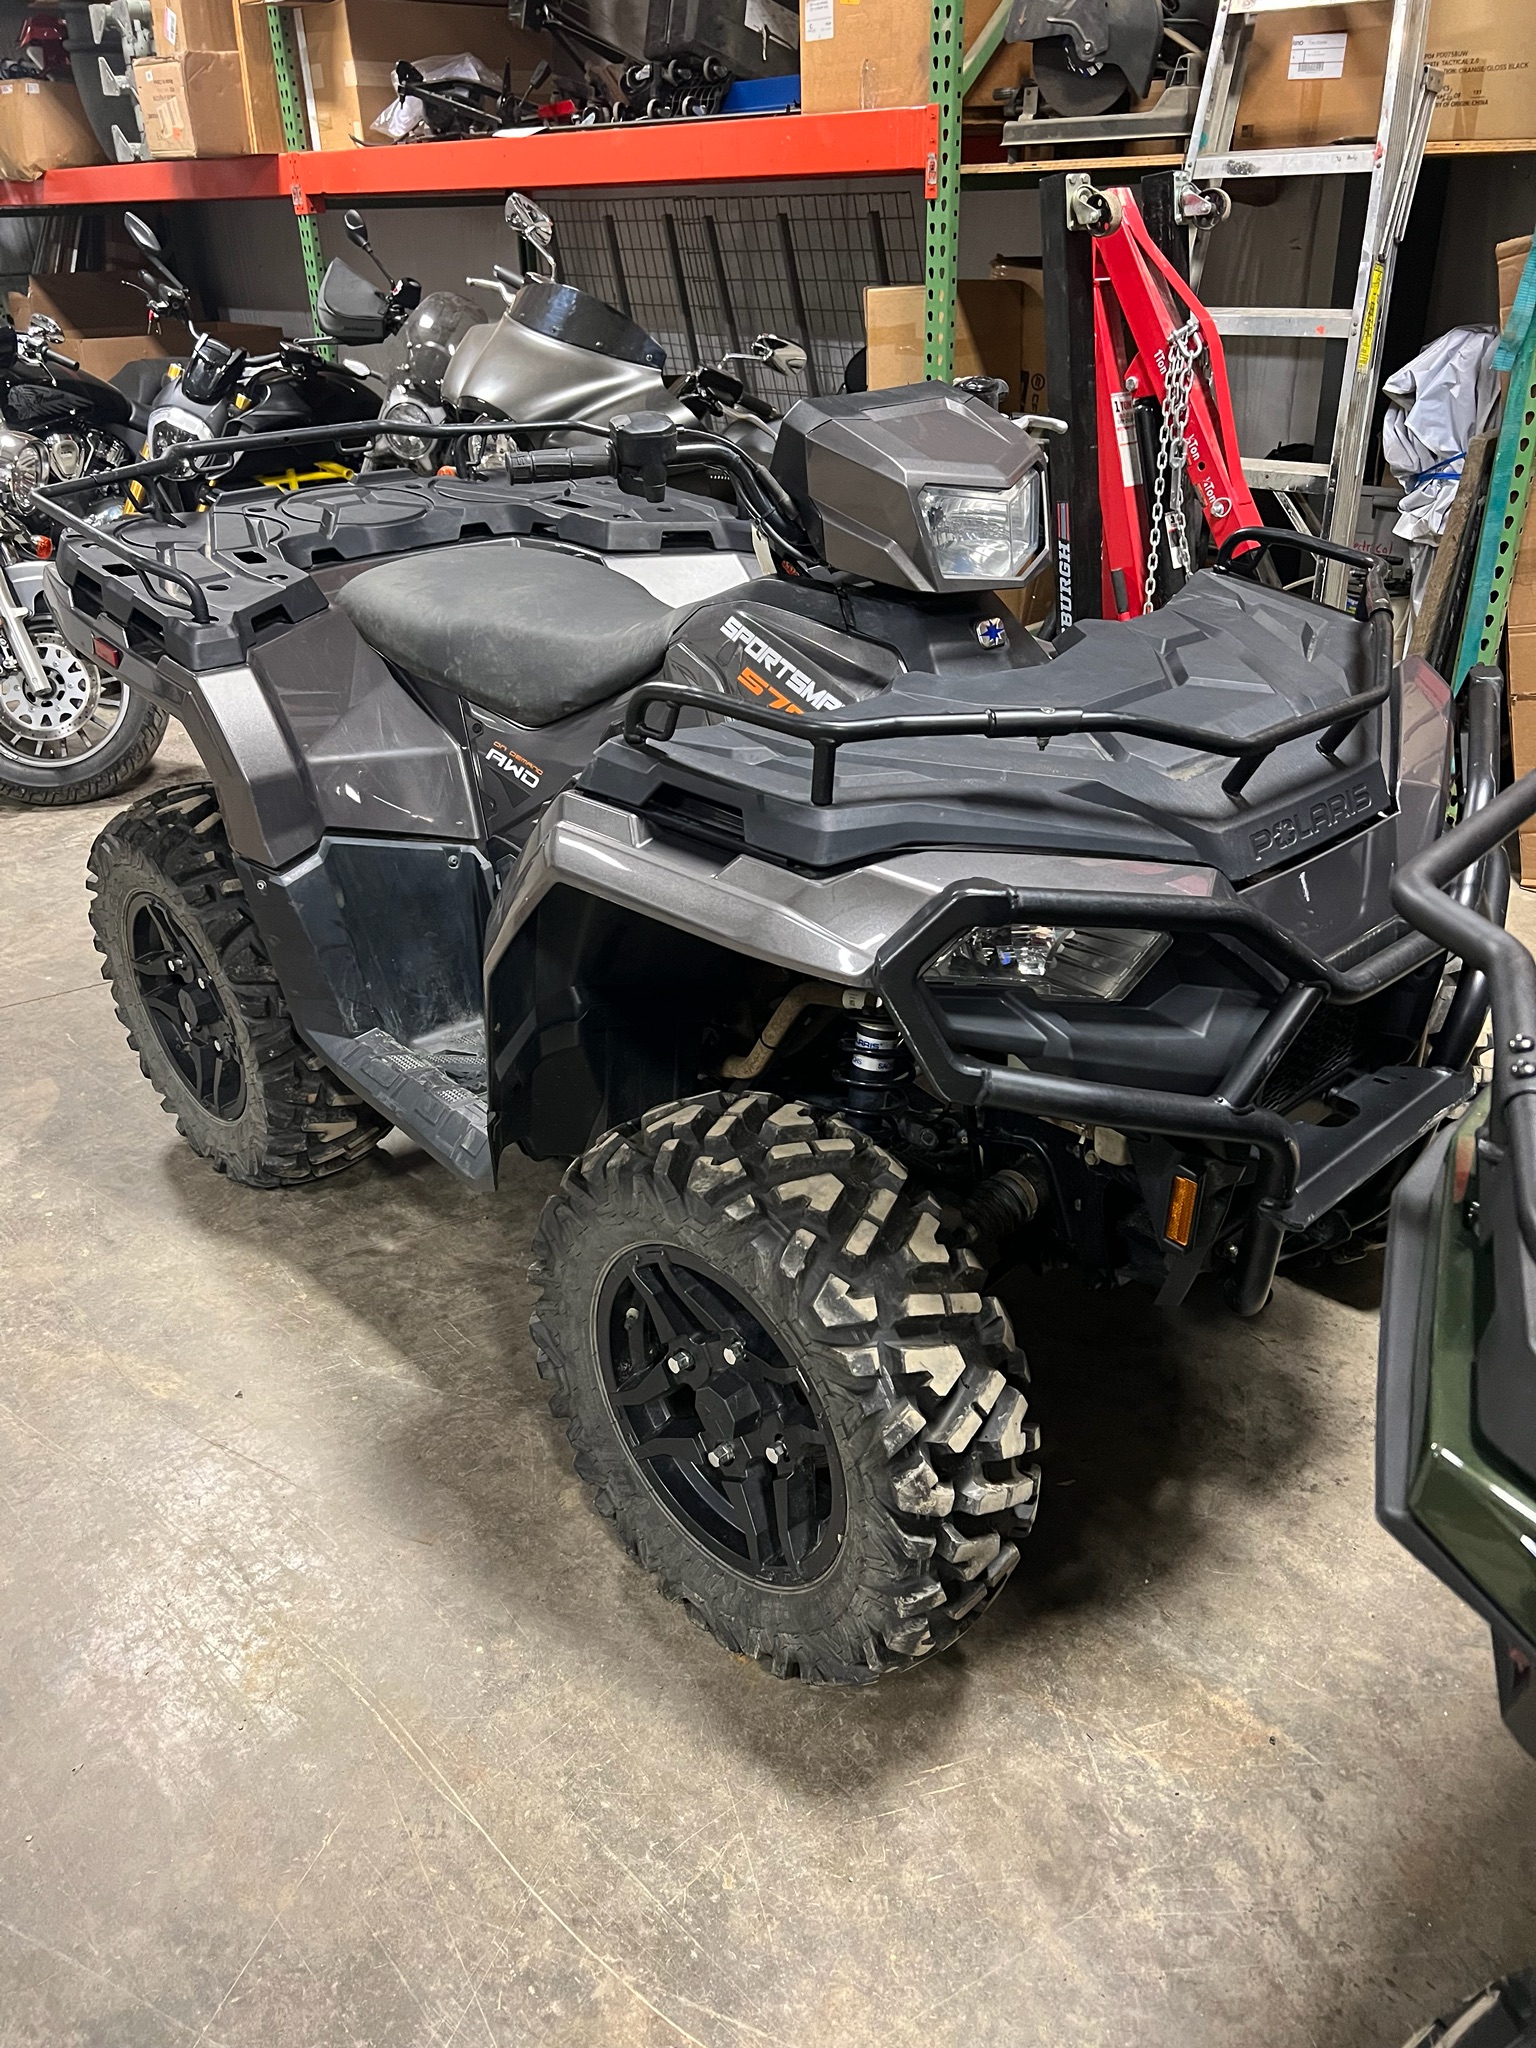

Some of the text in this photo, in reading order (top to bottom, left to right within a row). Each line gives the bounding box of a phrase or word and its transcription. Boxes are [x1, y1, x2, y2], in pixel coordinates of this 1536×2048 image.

[1508, 61, 1529, 70] BLACK
[1058, 540, 1073, 633] BURGH
[720, 615, 845, 711] SPORTSMA
[485, 748, 540, 789] AWD
[1249, 783, 1372, 861] POLARIS
